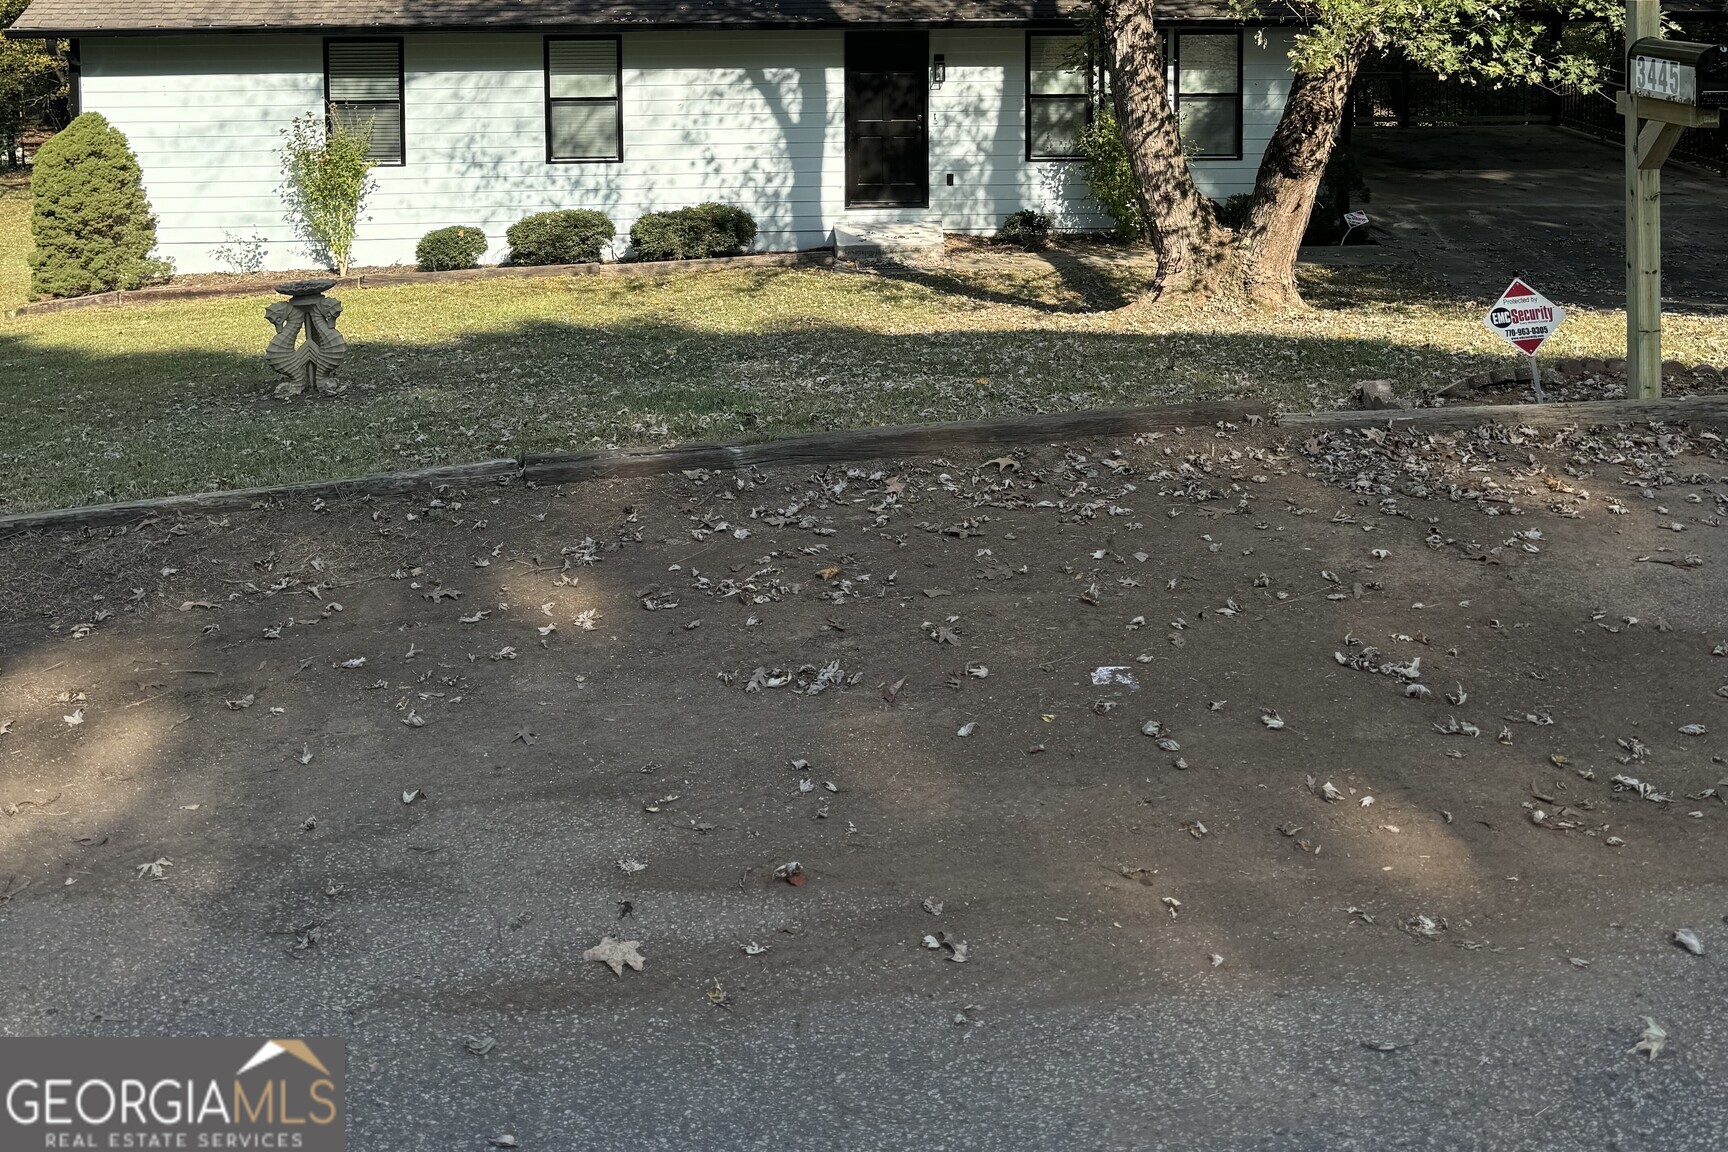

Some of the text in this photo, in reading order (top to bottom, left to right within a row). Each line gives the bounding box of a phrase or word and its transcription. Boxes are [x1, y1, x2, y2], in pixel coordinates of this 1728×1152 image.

[1637, 56, 1679, 94] 3445
[1503, 297, 1529, 305] Protected
[1492, 305, 1553, 325] EMC Security
[1505, 326, 1548, 337] 770-963-0305
